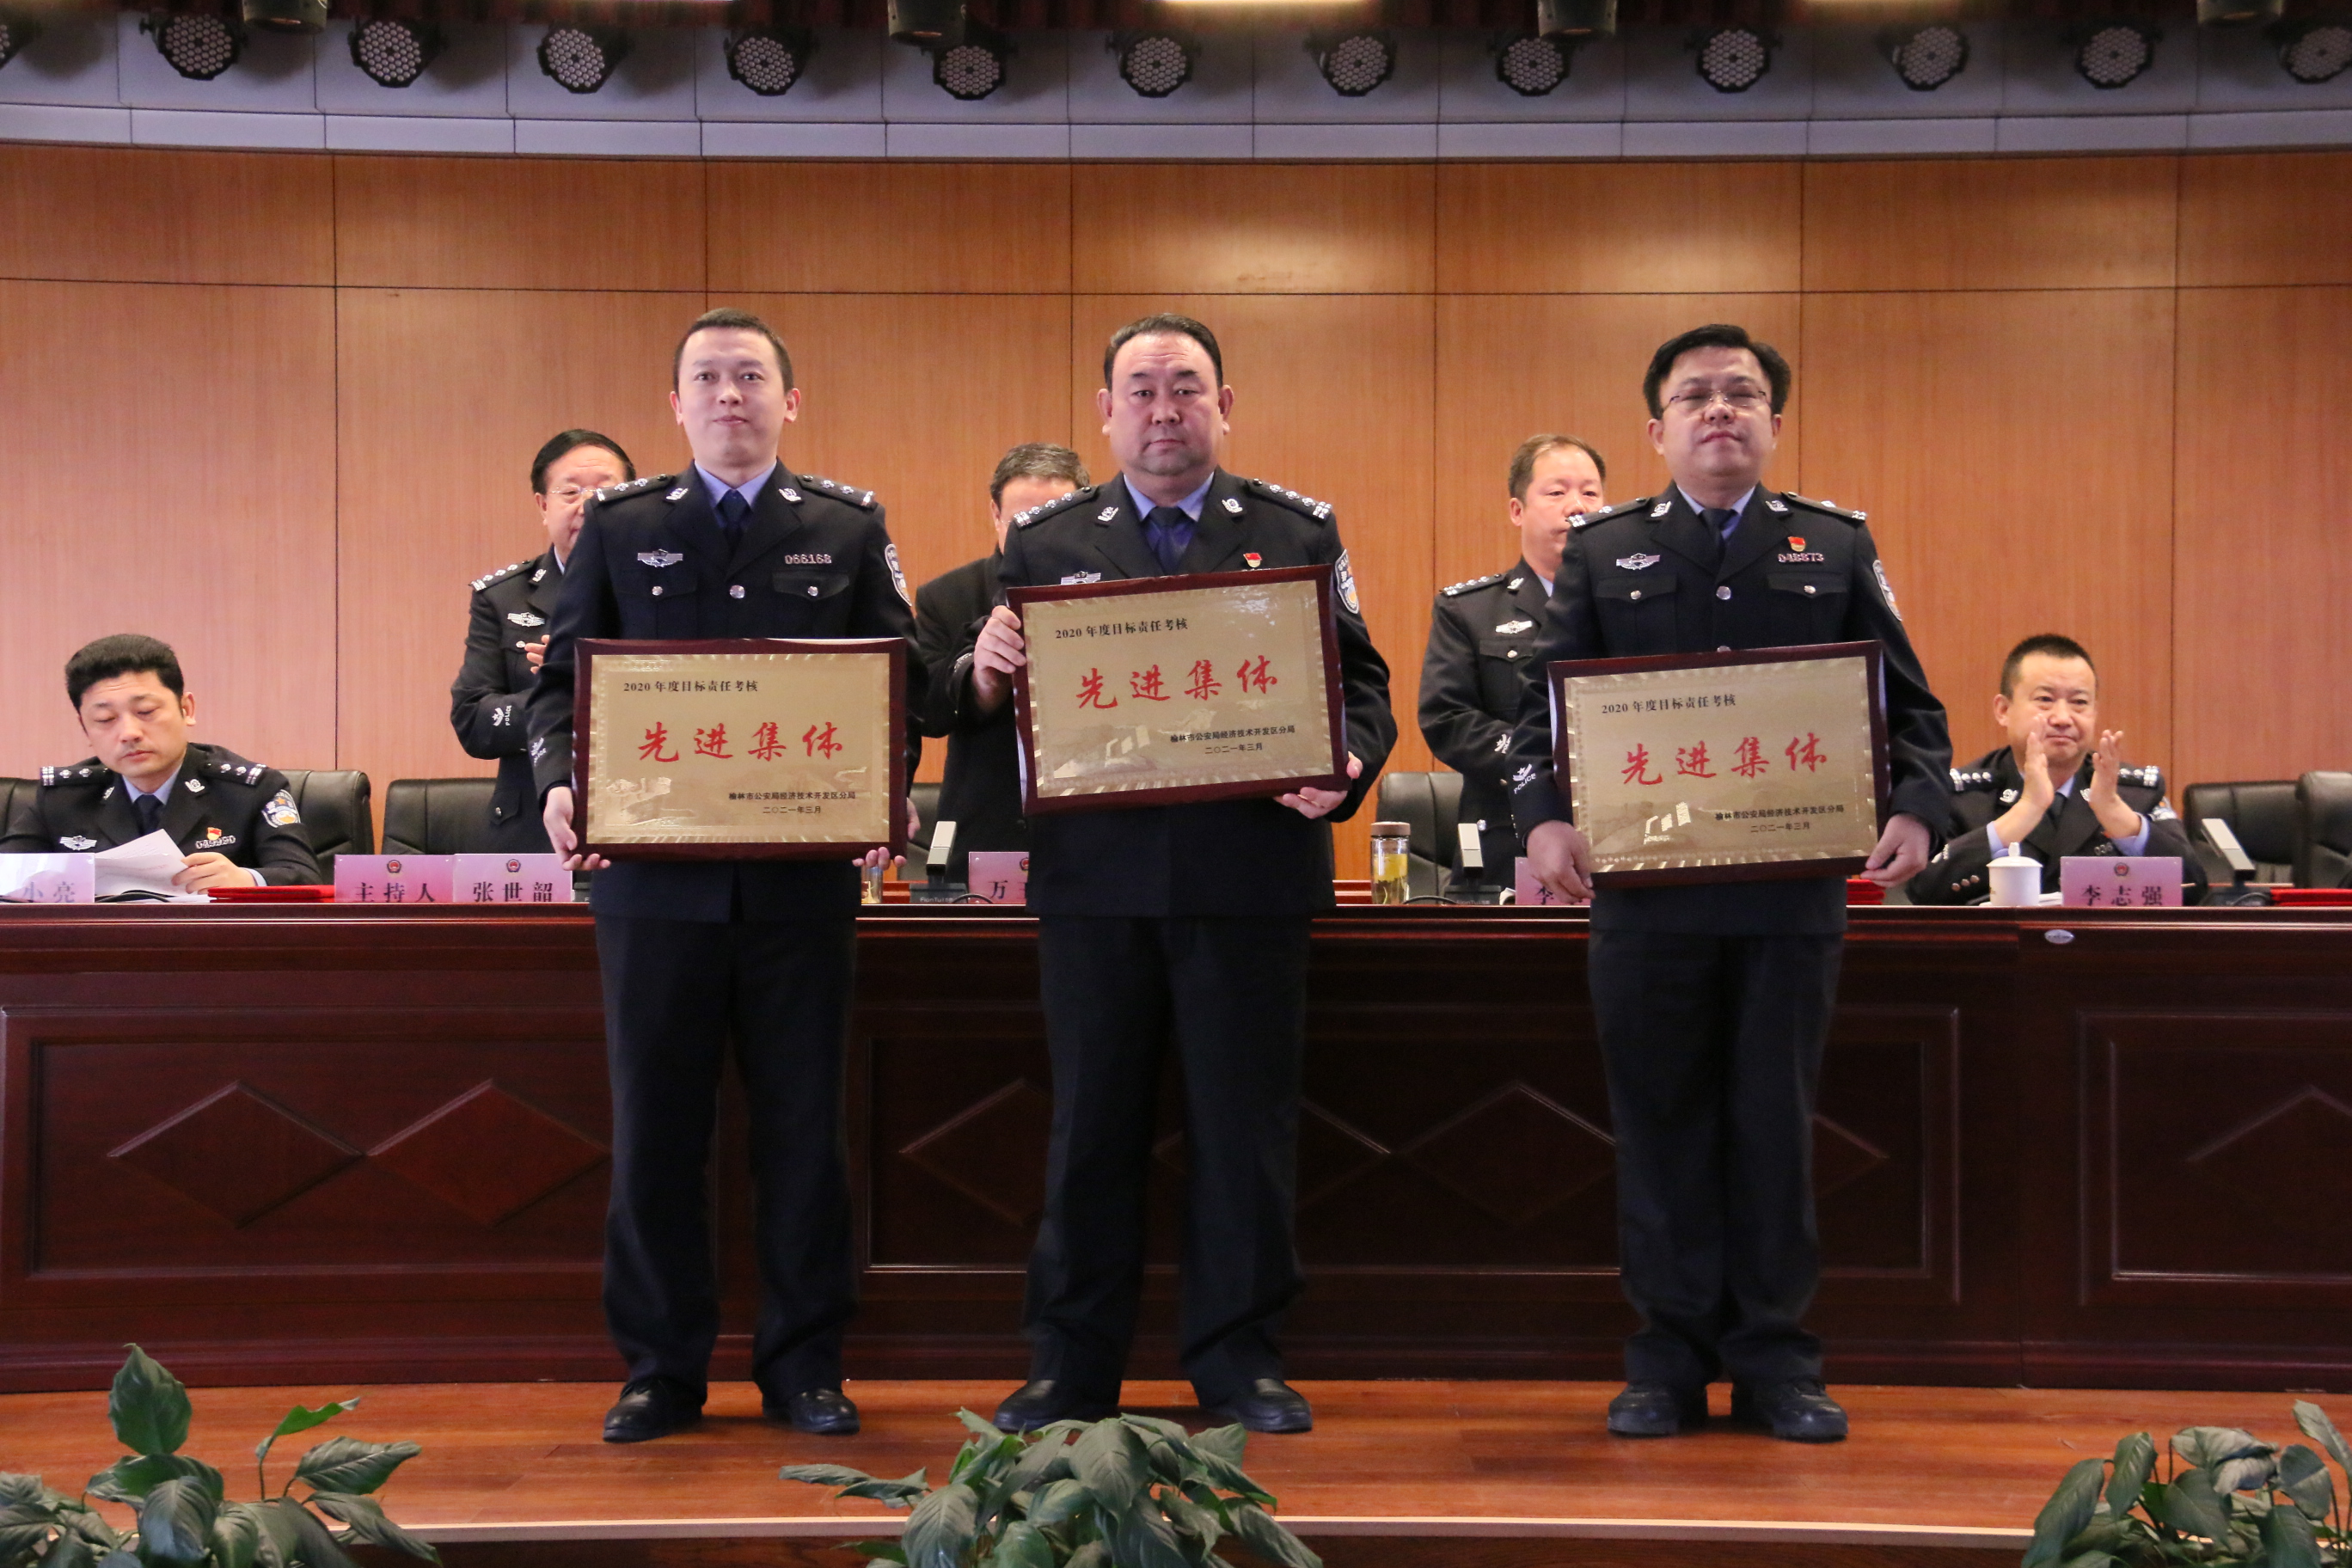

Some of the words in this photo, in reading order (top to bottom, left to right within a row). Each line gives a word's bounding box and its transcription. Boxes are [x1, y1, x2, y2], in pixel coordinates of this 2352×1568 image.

[1075, 654, 1277, 710] 先进集体
[638, 720, 843, 763] 先进集体
[1169, 724, 1295, 744] 榆林市公安局经济技术开发区分局
[1620, 732, 1828, 786] 先进集体
[1514, 773, 1536, 794] POLICE
[728, 791, 856, 801] 榆林市公安局经济技术开发区分局
[1714, 804, 1845, 821] 榆林市公安局经济技术开发区分局
[355, 882, 436, 903] 主持人
[2082, 885, 2163, 906] 李志强
